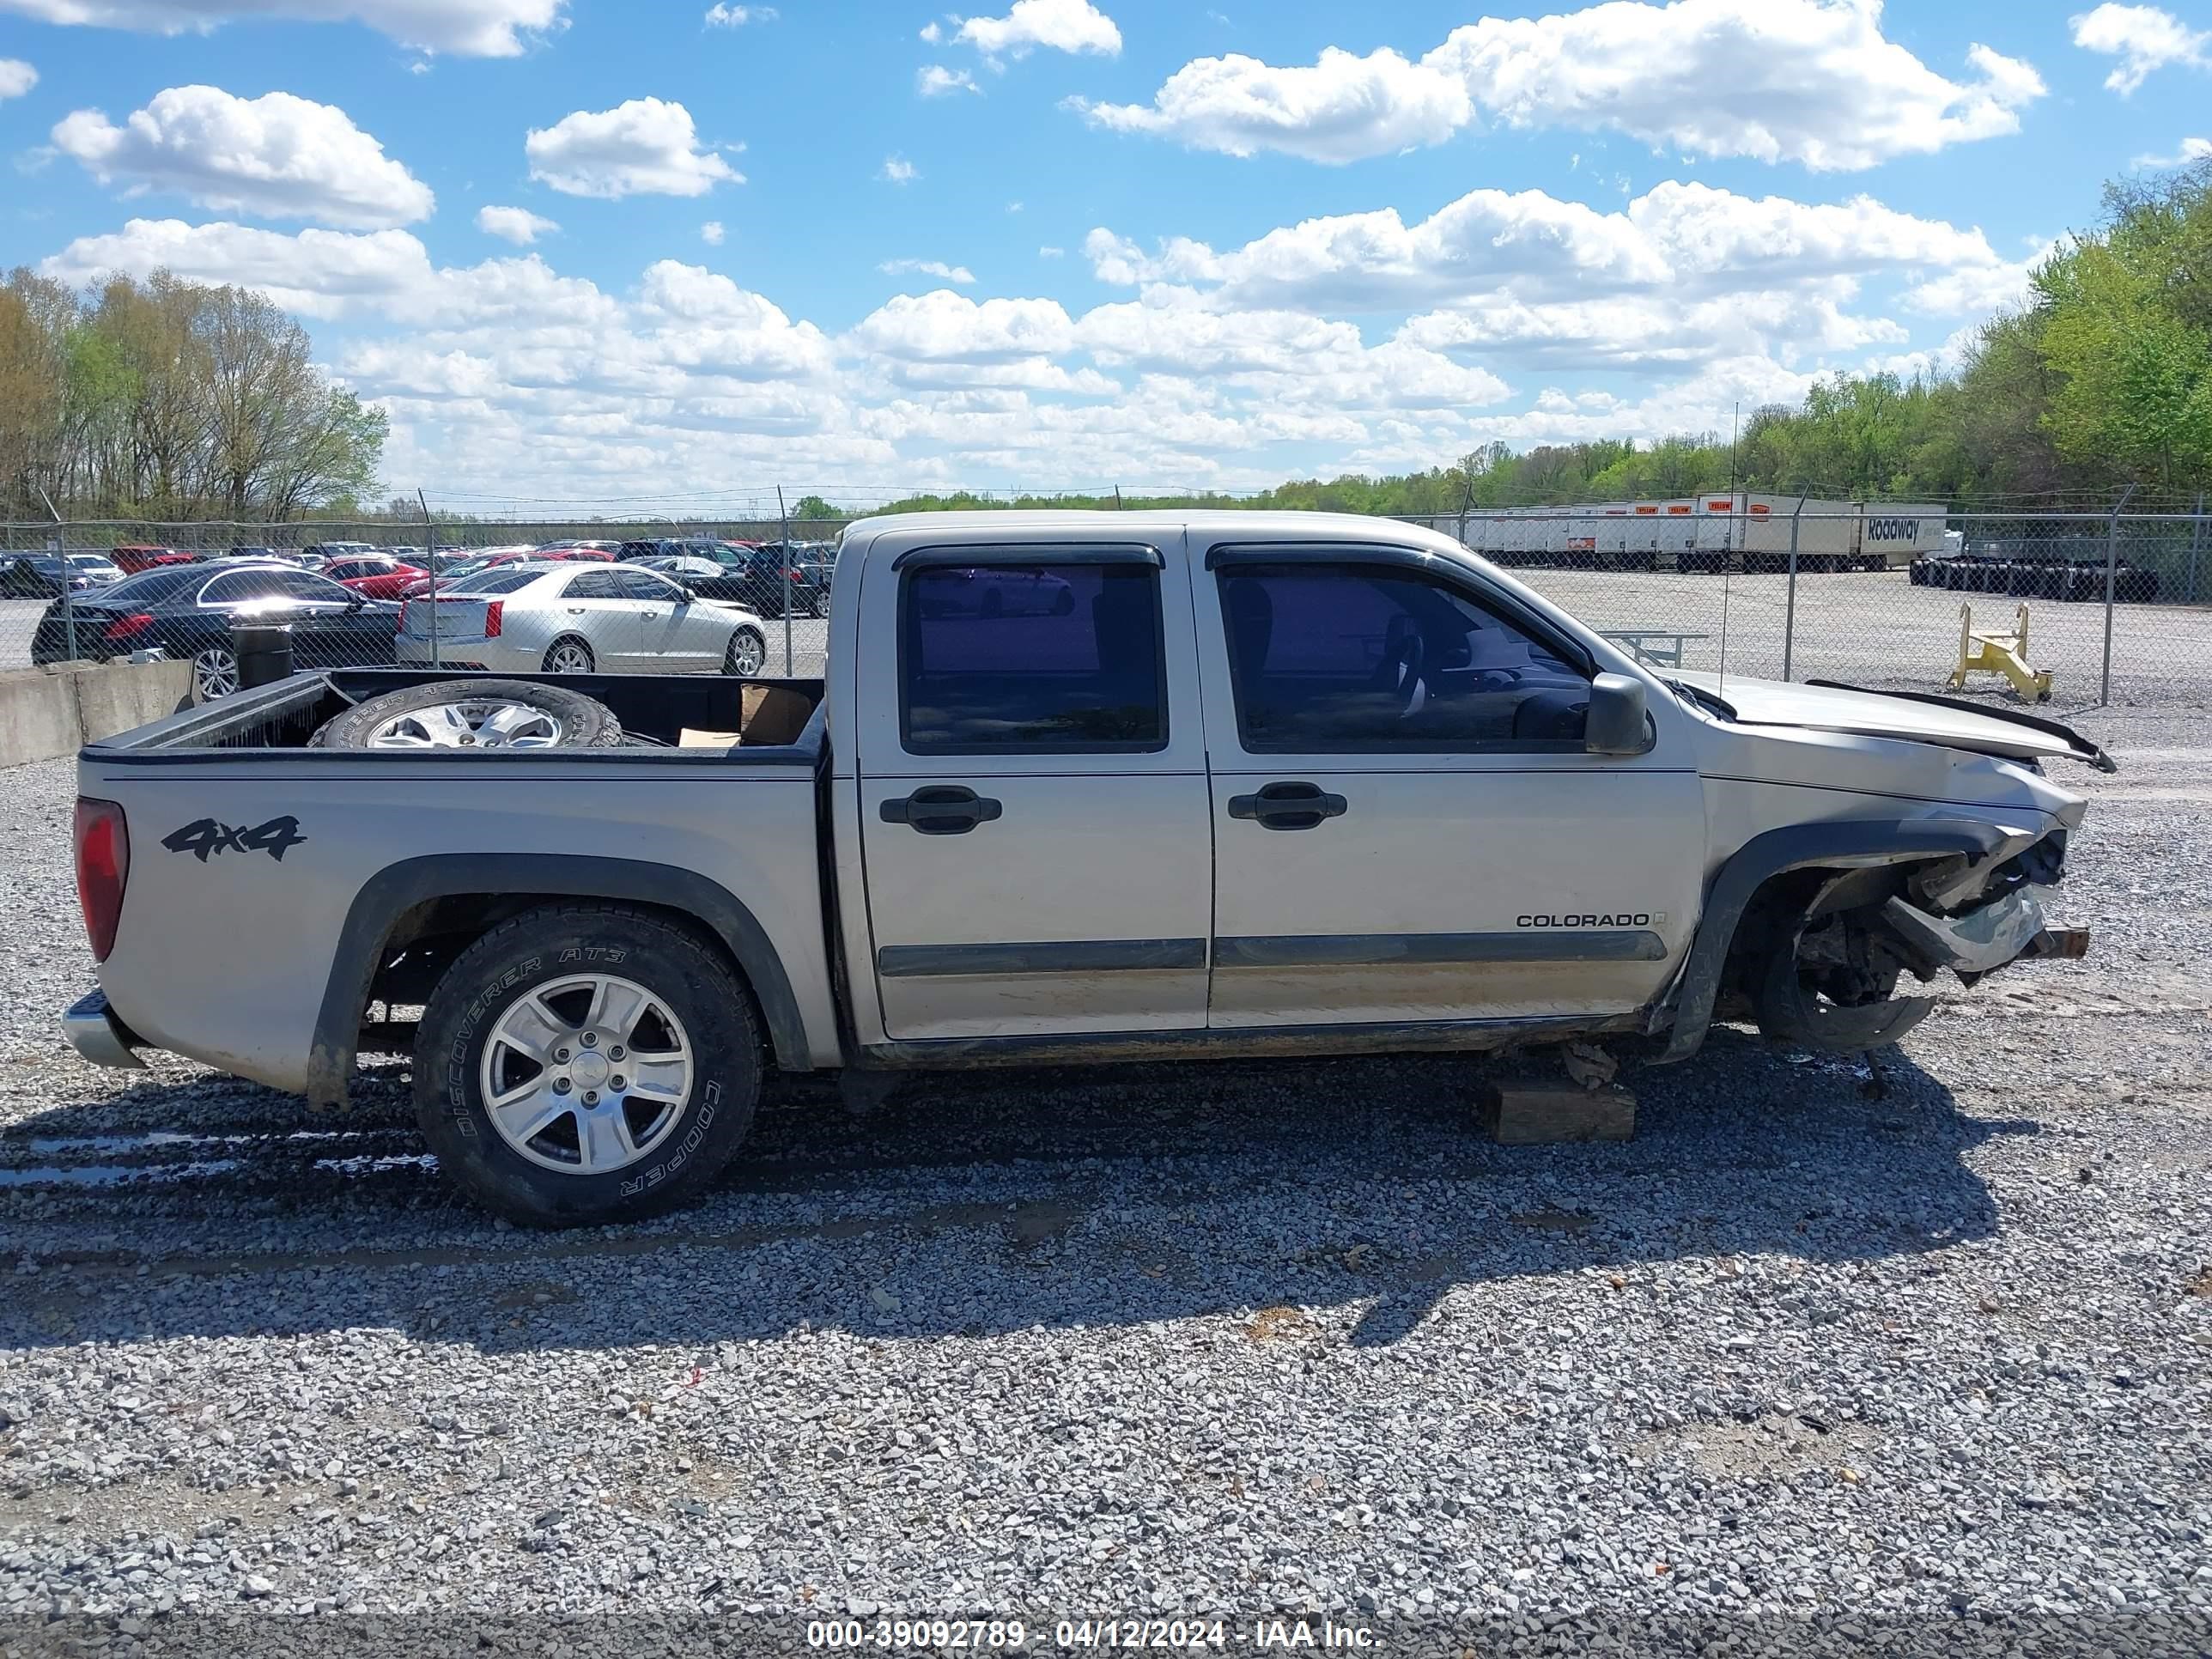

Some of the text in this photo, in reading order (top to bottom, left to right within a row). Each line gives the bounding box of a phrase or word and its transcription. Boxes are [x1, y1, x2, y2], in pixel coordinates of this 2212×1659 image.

[1868, 519, 1920, 545] Roadway
[1516, 913, 1650, 928] COLORADO
[446, 946, 628, 1139] DISCOVERER AT3
[619, 1079, 722, 1199] COOPER
